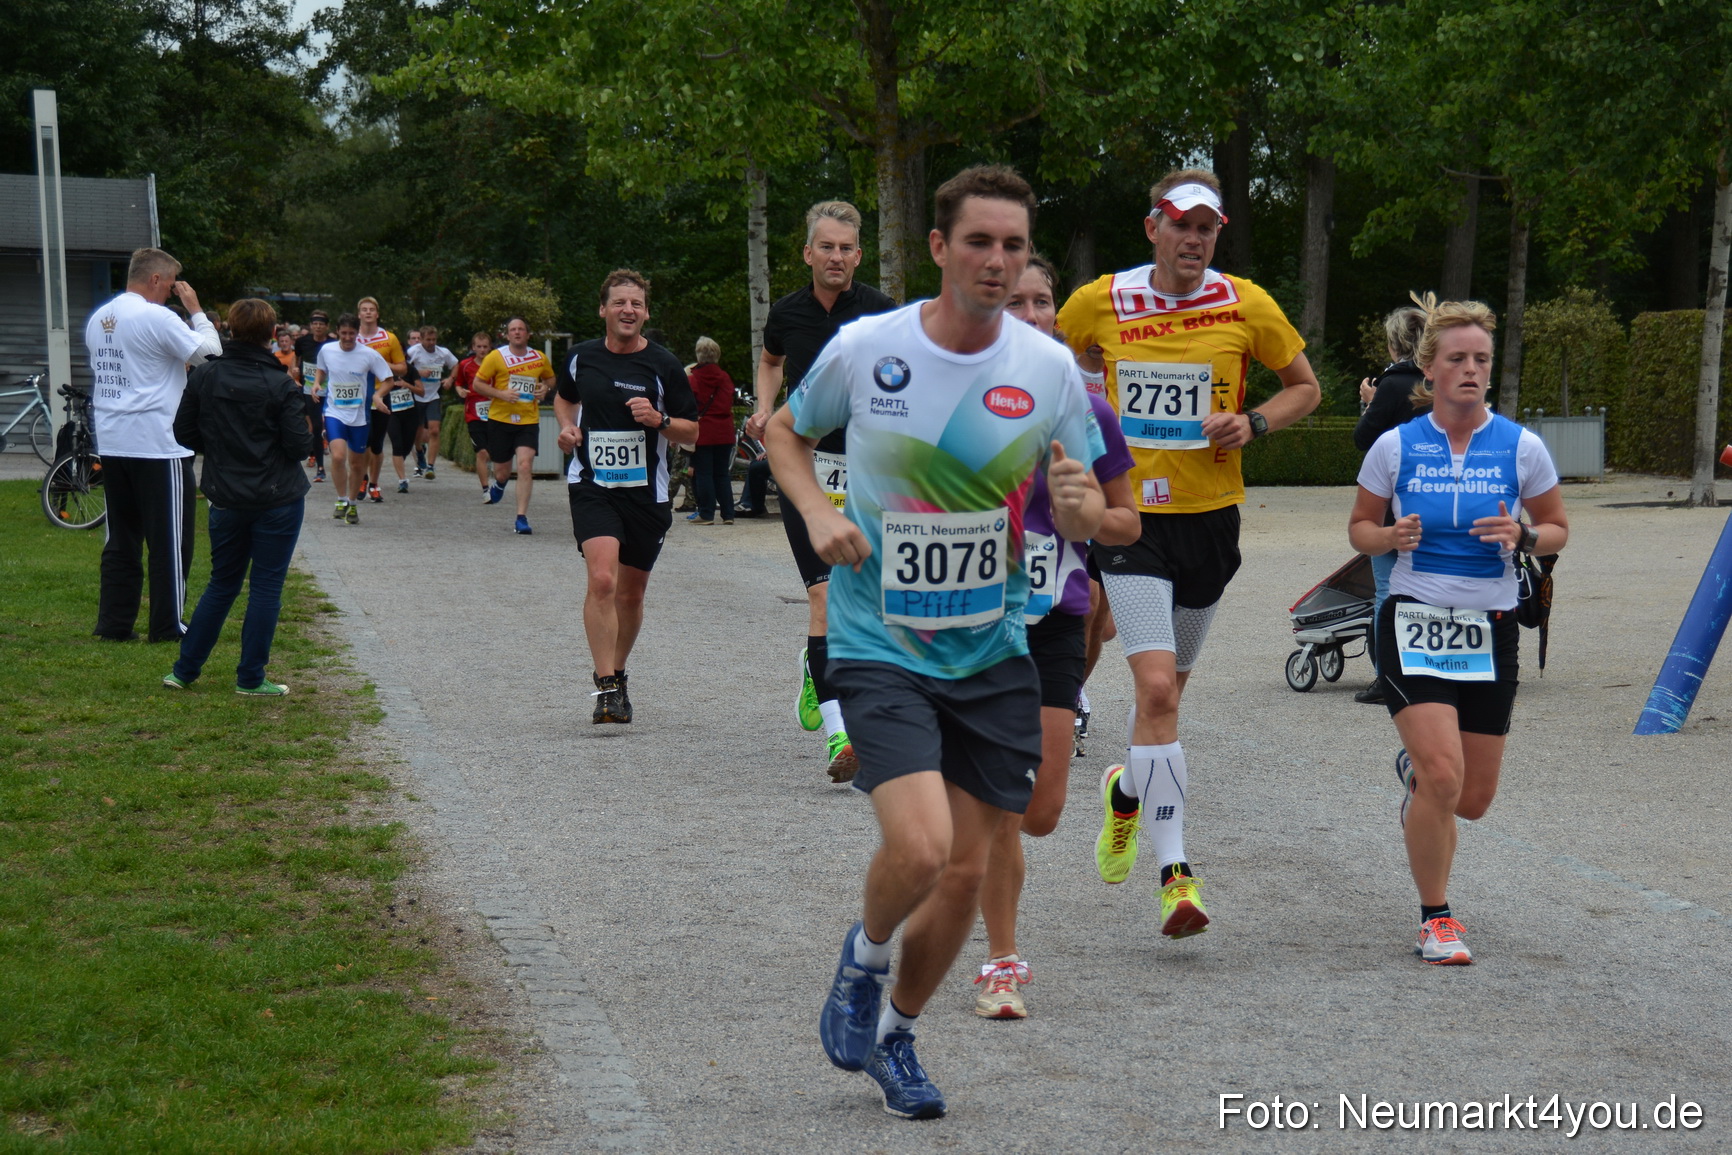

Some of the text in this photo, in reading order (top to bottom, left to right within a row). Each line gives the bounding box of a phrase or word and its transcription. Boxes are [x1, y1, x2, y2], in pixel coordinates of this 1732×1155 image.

[1119, 309, 1246, 345] MAX BÖGL
[96, 361, 122, 373] SEINER
[508, 366, 526, 374] MAX
[877, 357, 909, 372] BMW
[95, 374, 131, 387] AJESTÄT:
[1118, 368, 1195, 381] PARTL Neumarkt
[101, 388, 122, 399] JESUS
[335, 387, 360, 399] 2397
[511, 380, 535, 394] 2760
[392, 393, 411, 404] 2142
[870, 397, 909, 410] PARTL
[990, 392, 1030, 411] Hervis
[1126, 382, 1199, 417] 2731
[869, 407, 909, 418] Neumarkt
[1141, 423, 1182, 439] Jürgen
[594, 444, 641, 467] 2591
[813, 456, 832, 465] ARTL
[606, 471, 629, 481] Claus
[1415, 463, 1502, 481] Radsport
[1407, 477, 1508, 494] Neumüller
[886, 523, 991, 536] PARTL Neumarkt
[896, 538, 997, 585] 3078
[900, 588, 973, 618] Pfiff
[1397, 610, 1427, 620] PARTL
[1406, 621, 1483, 652] 2820
[1424, 656, 1469, 671] Martina
